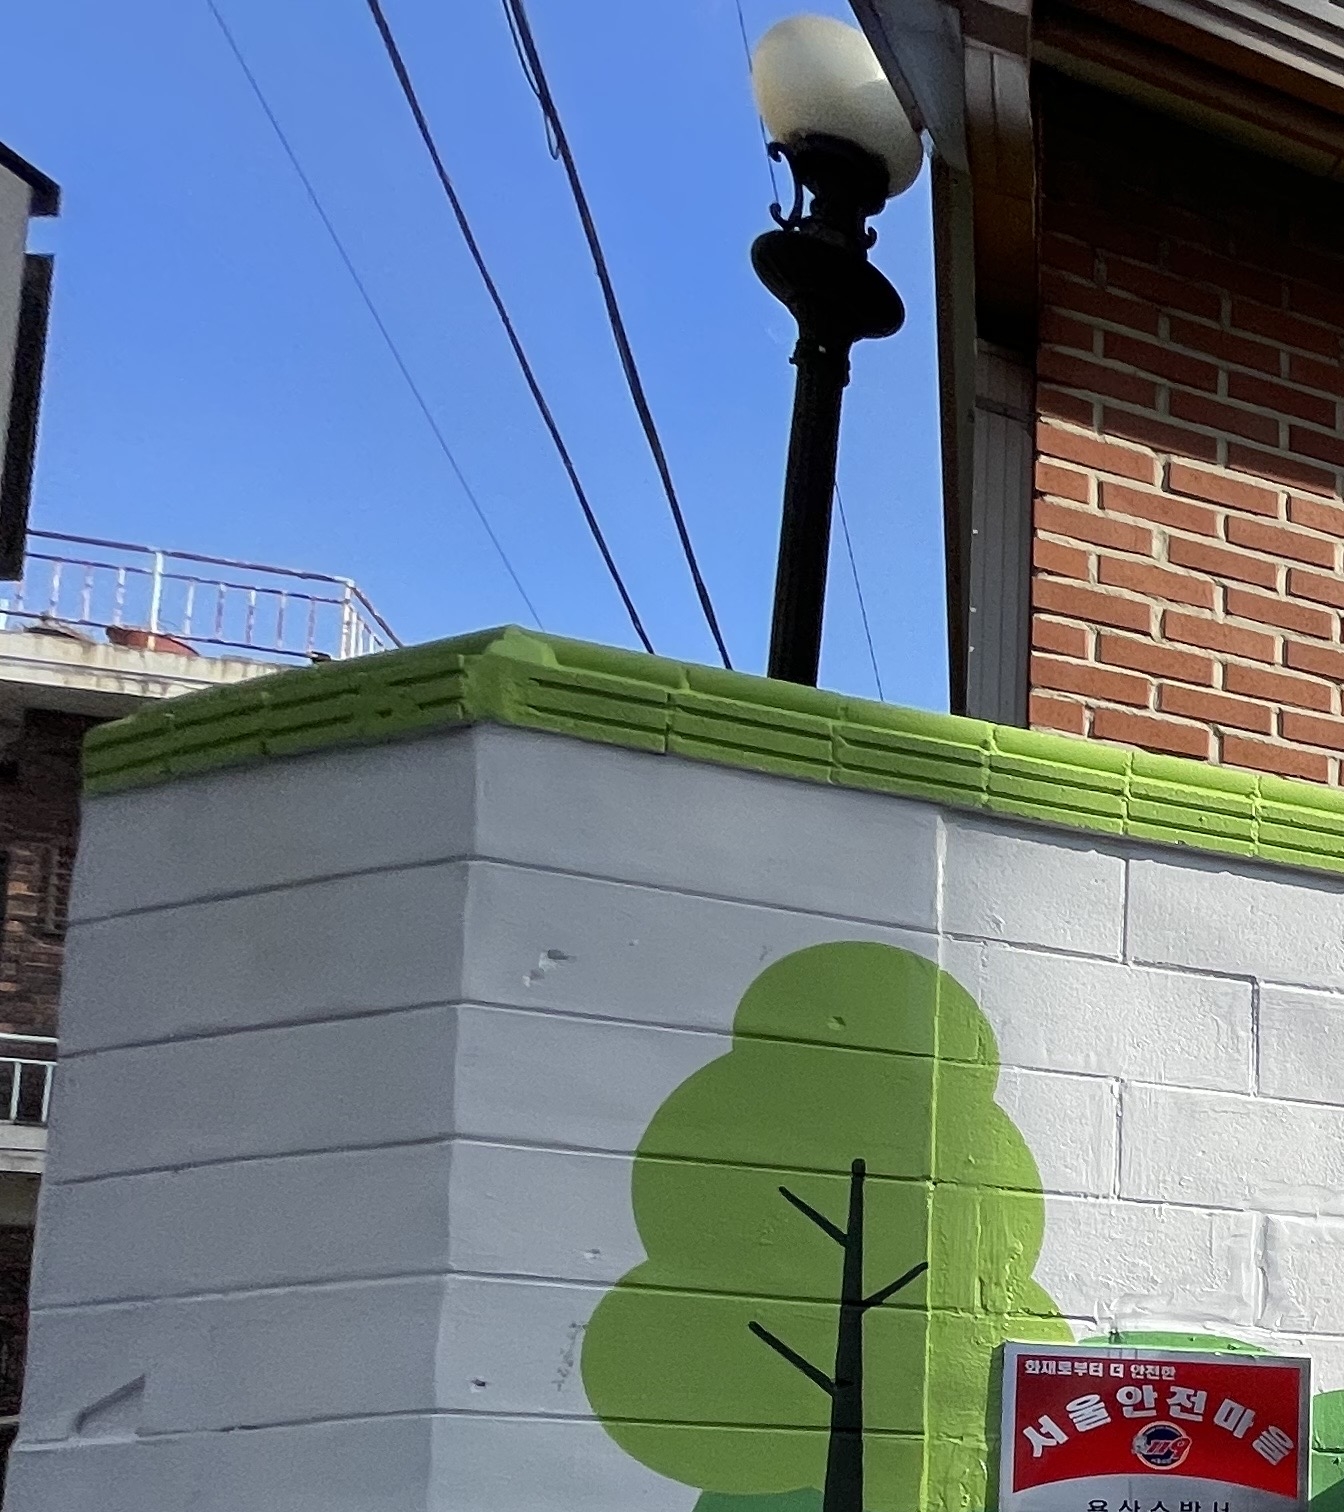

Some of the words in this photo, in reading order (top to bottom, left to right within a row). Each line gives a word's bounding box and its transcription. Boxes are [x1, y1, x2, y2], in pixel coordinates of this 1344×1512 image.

[1024, 1359, 1103, 1378] 화재로부터
[1109, 1363, 1124, 1378] 더
[1130, 1364, 1176, 1380] 안전한
[1022, 1384, 1294, 1466] 서울안전마을
